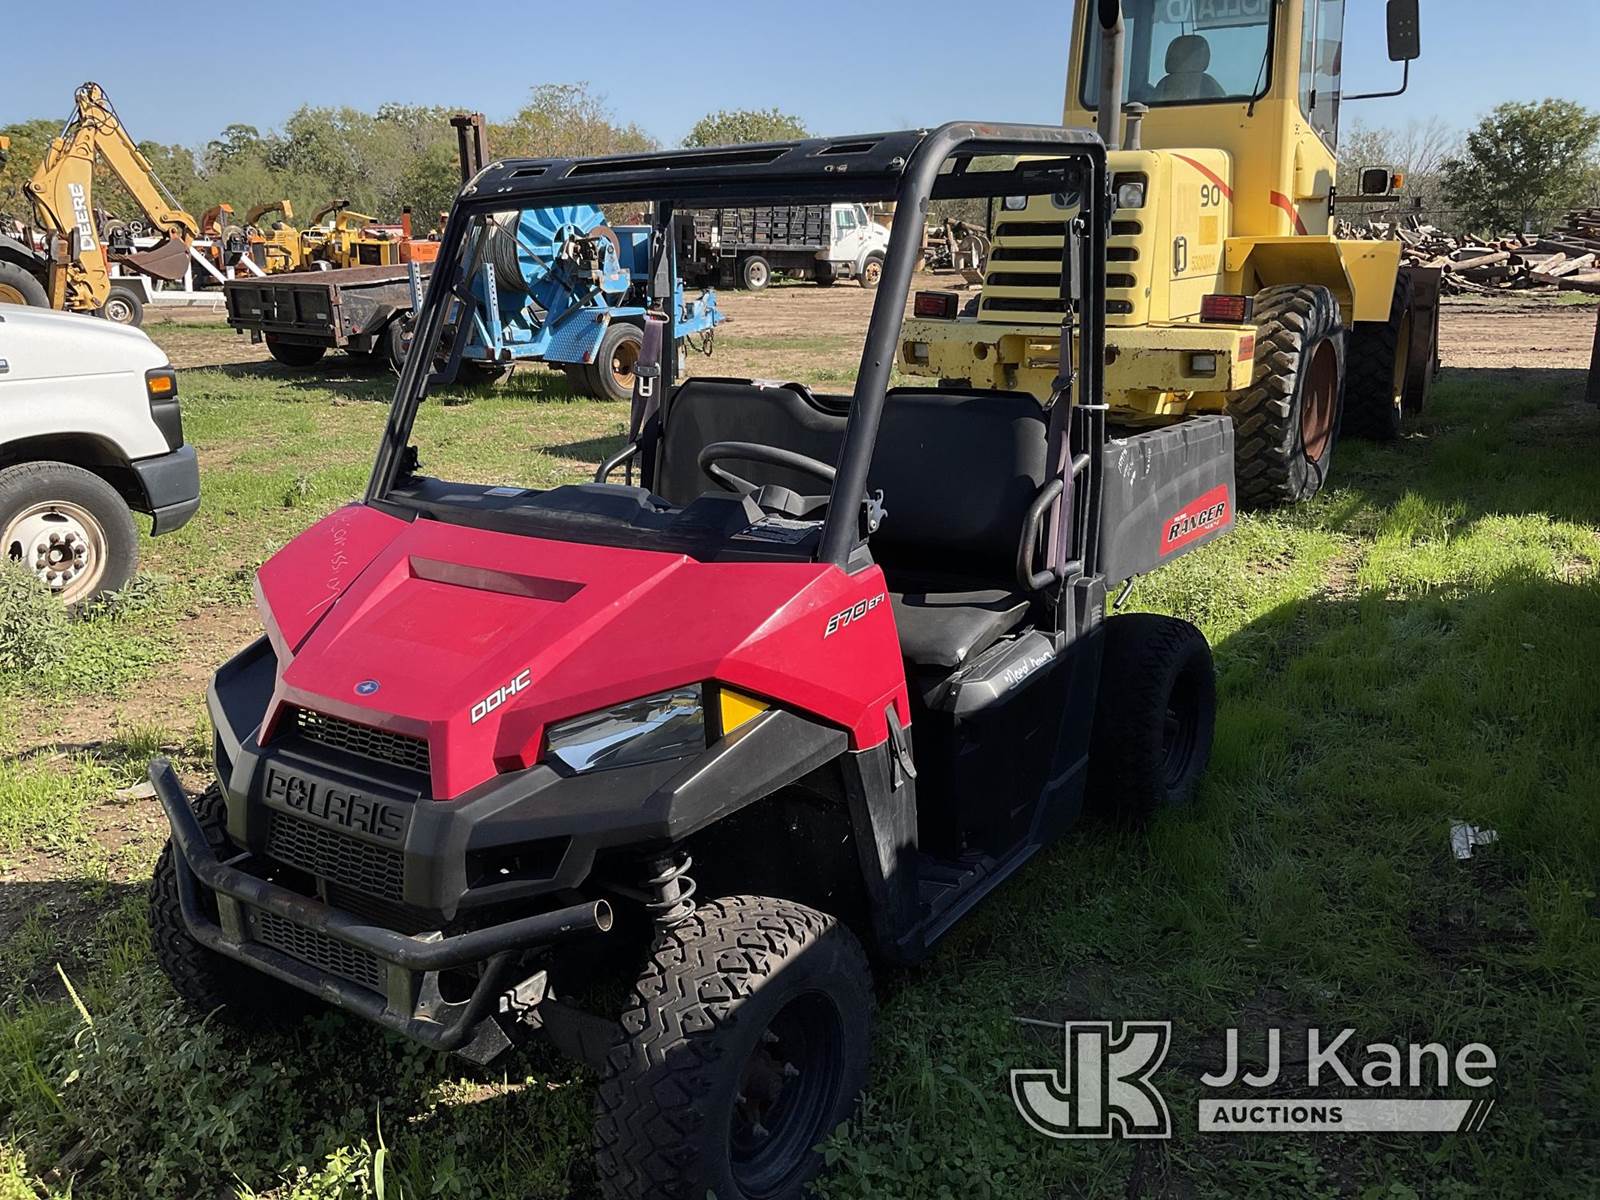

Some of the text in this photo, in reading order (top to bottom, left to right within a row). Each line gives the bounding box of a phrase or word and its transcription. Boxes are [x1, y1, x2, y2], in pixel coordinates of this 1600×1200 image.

[67, 184, 97, 250] DEERE
[1200, 184, 1221, 207] 90
[1167, 501, 1225, 543] RANGER
[824, 599, 868, 639] 570
[470, 668, 531, 724] DOHC
[265, 767, 405, 841] POLARIS
